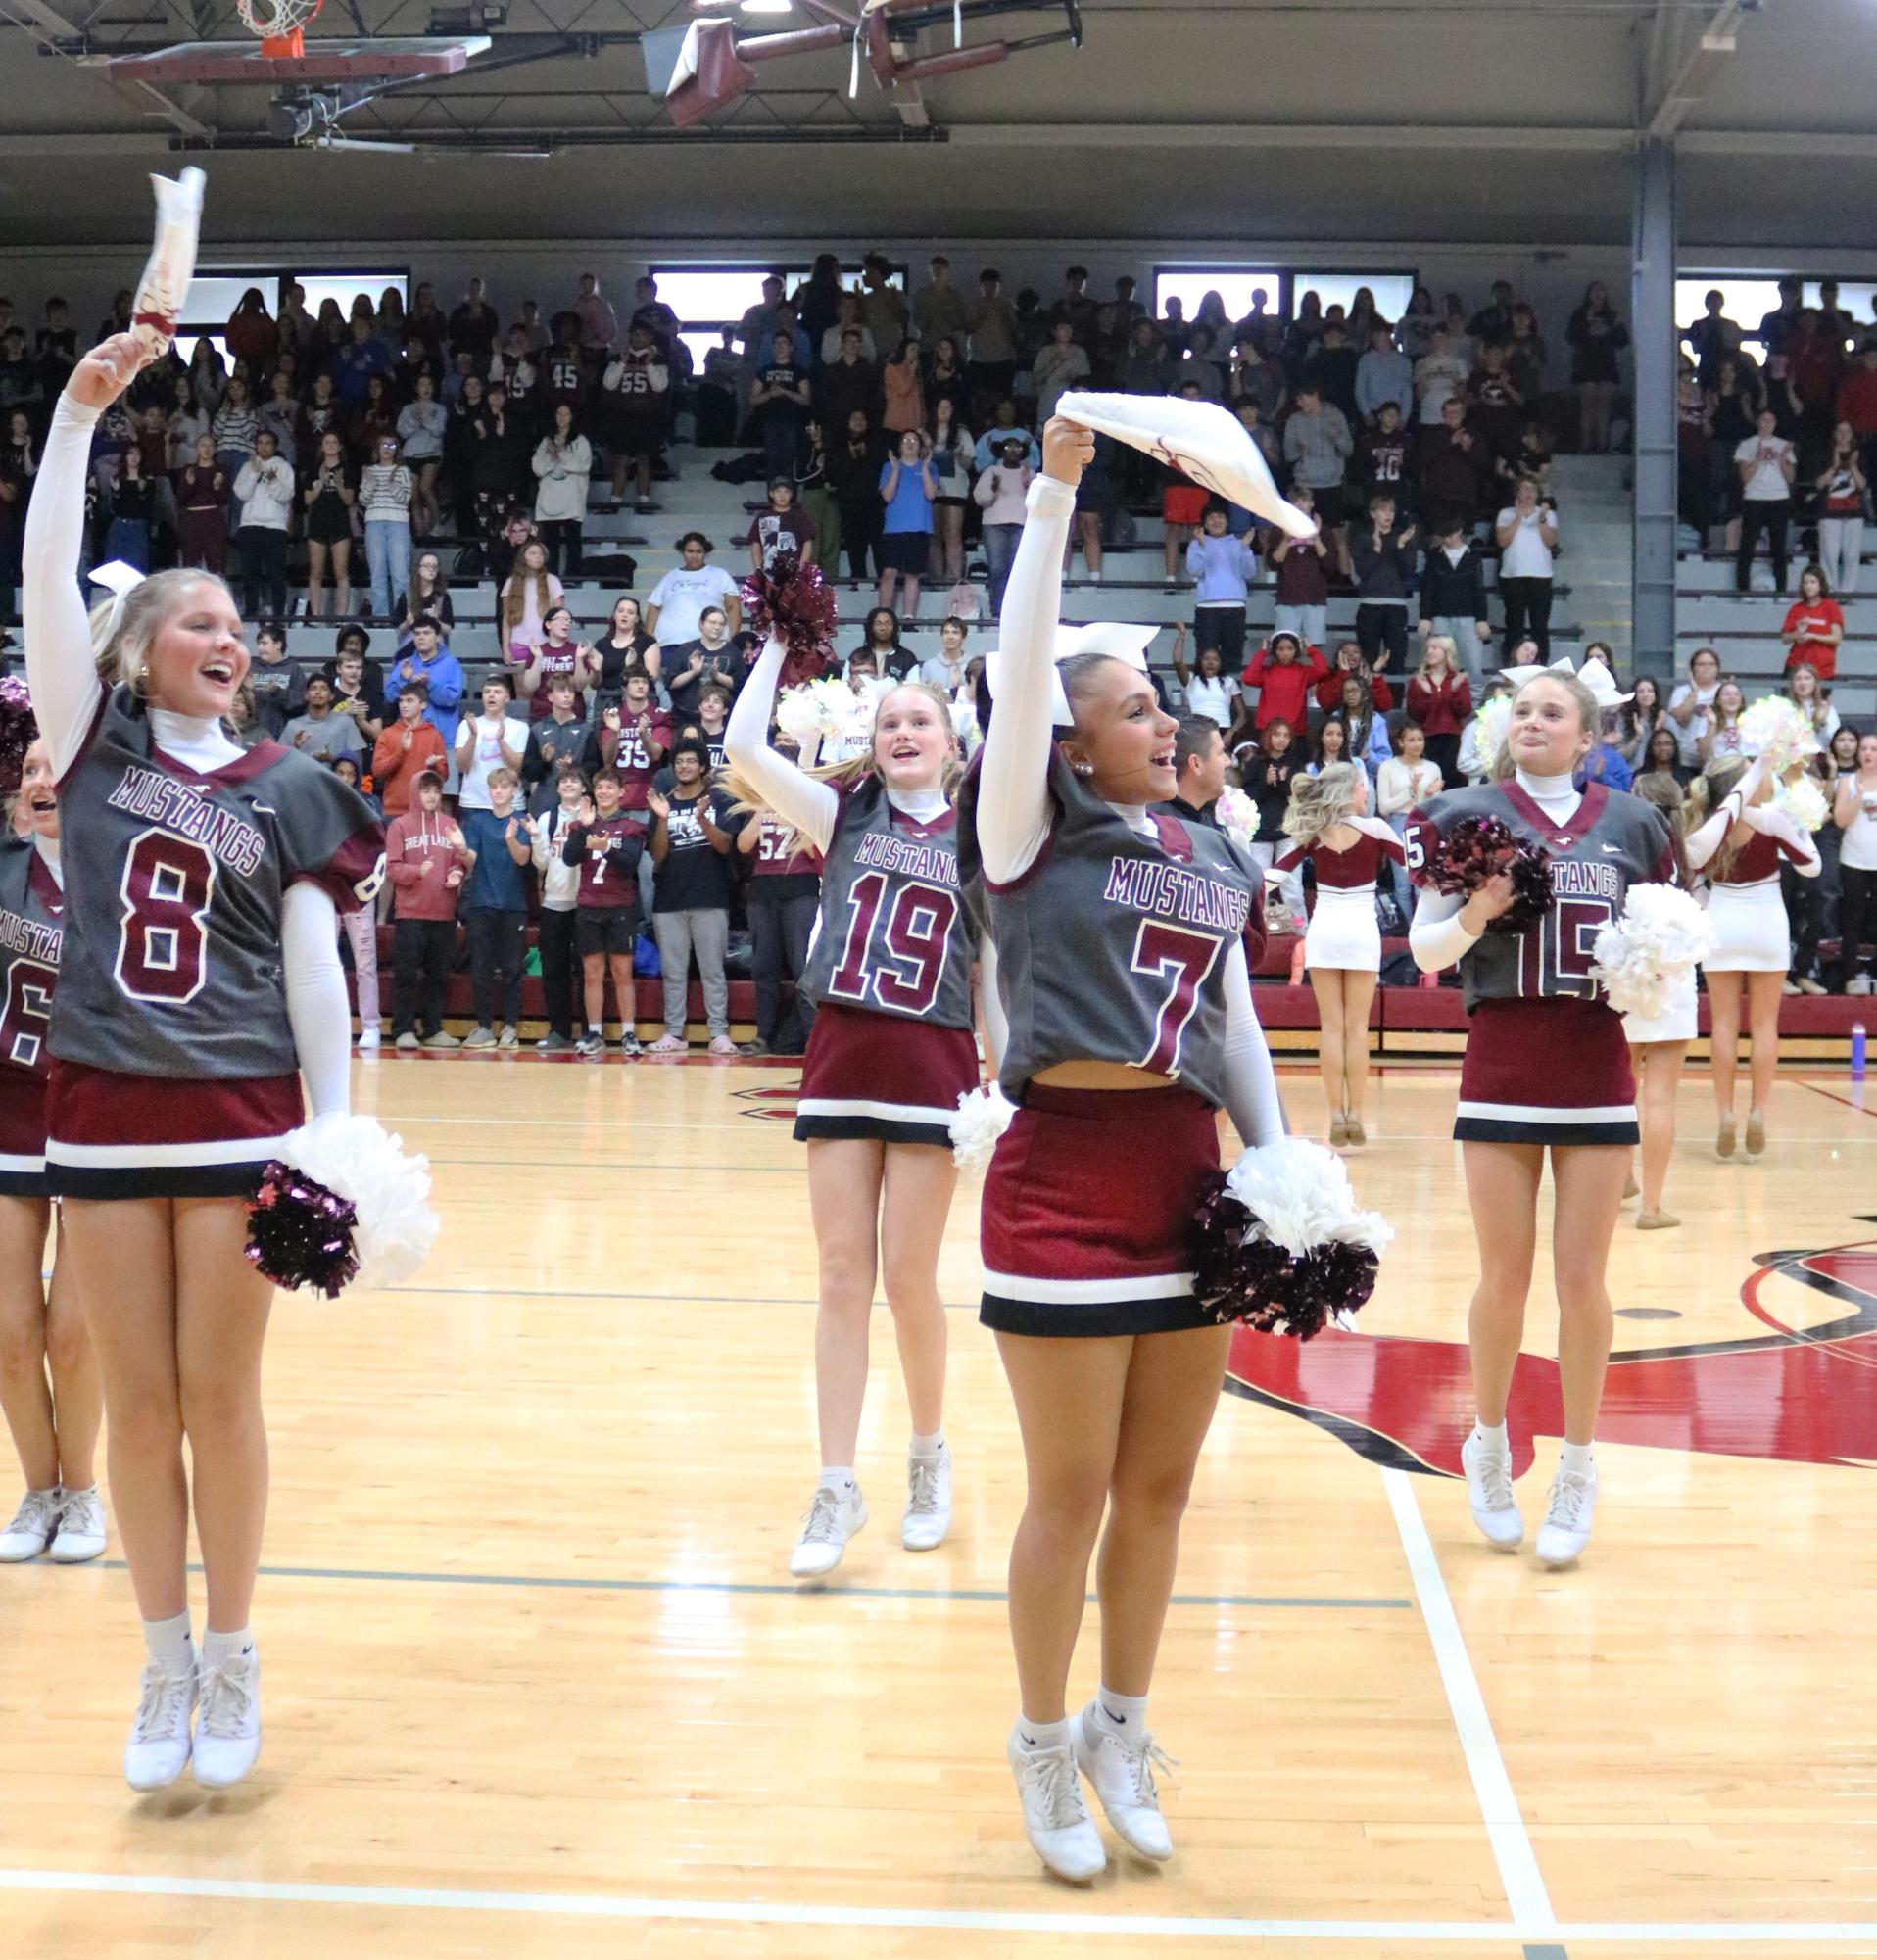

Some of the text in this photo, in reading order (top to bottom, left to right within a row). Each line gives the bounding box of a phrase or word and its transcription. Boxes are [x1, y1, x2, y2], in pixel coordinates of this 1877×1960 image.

[621, 371, 648, 393] 55
[108, 766, 265, 877] MUSTANGS
[854, 833, 960, 887] MUSTANG
[591, 849, 608, 884] 7
[1104, 856, 1249, 934] MUSTANGS
[1549, 860, 1618, 900] TANGS
[114, 826, 218, 1005] 8
[828, 870, 959, 1016] 19
[1124, 917, 1225, 1081] 7
